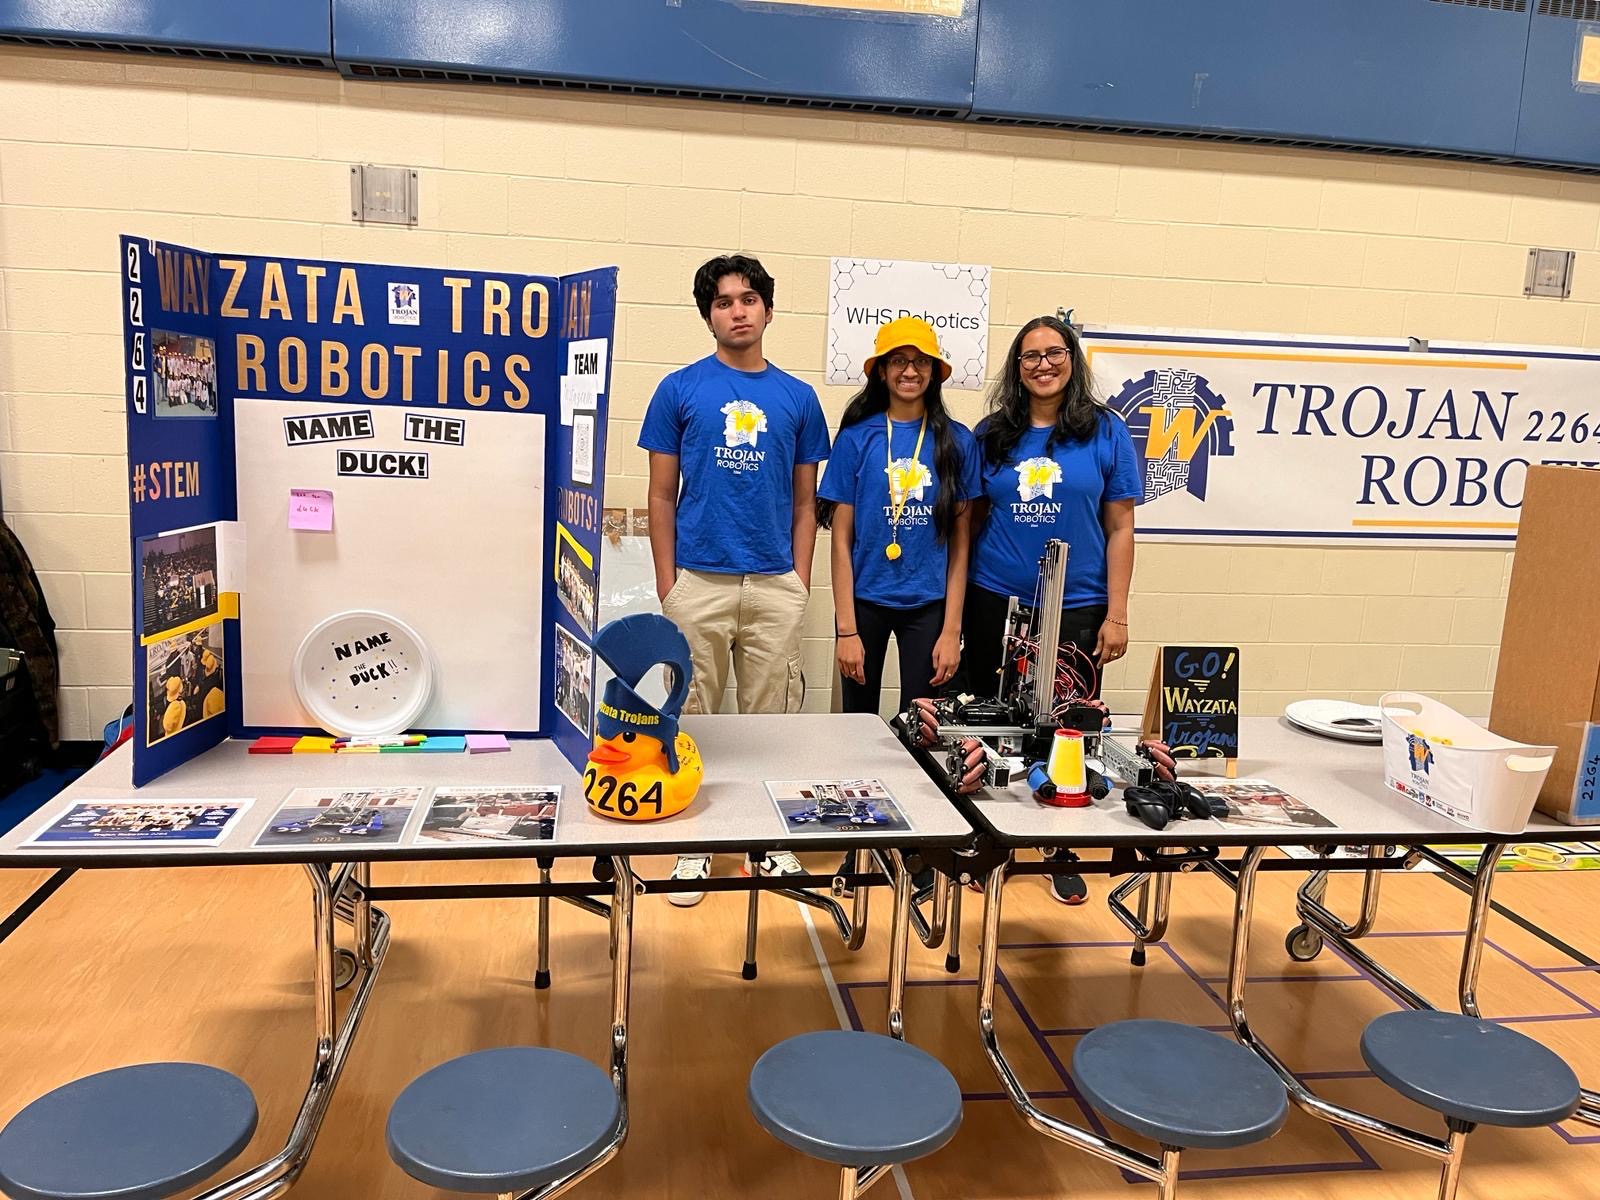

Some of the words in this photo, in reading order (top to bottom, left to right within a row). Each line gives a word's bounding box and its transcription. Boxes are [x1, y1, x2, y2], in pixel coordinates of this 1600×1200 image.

[846, 307, 892, 325] WHS
[236, 334, 531, 410] ROBOTICS
[574, 353, 598, 375] TEAM
[1253, 382, 1518, 442] TROJAN
[286, 415, 371, 441] NAME
[409, 417, 461, 442] THE
[340, 452, 426, 476] DUCK!
[714, 446, 766, 463] TROJAN
[716, 459, 759, 471] ROBOTICS
[133, 461, 200, 503] #STEM
[1010, 502, 1062, 516] TROJAN
[1014, 514, 1056, 524] ROBOTICS
[334, 632, 391, 661] NAME
[353, 663, 366, 671] THE
[1174, 651, 1235, 680] GO!
[620, 709, 659, 725] Trojans
[584, 768, 663, 817] 2264
[836, 824, 861, 832] 2023
